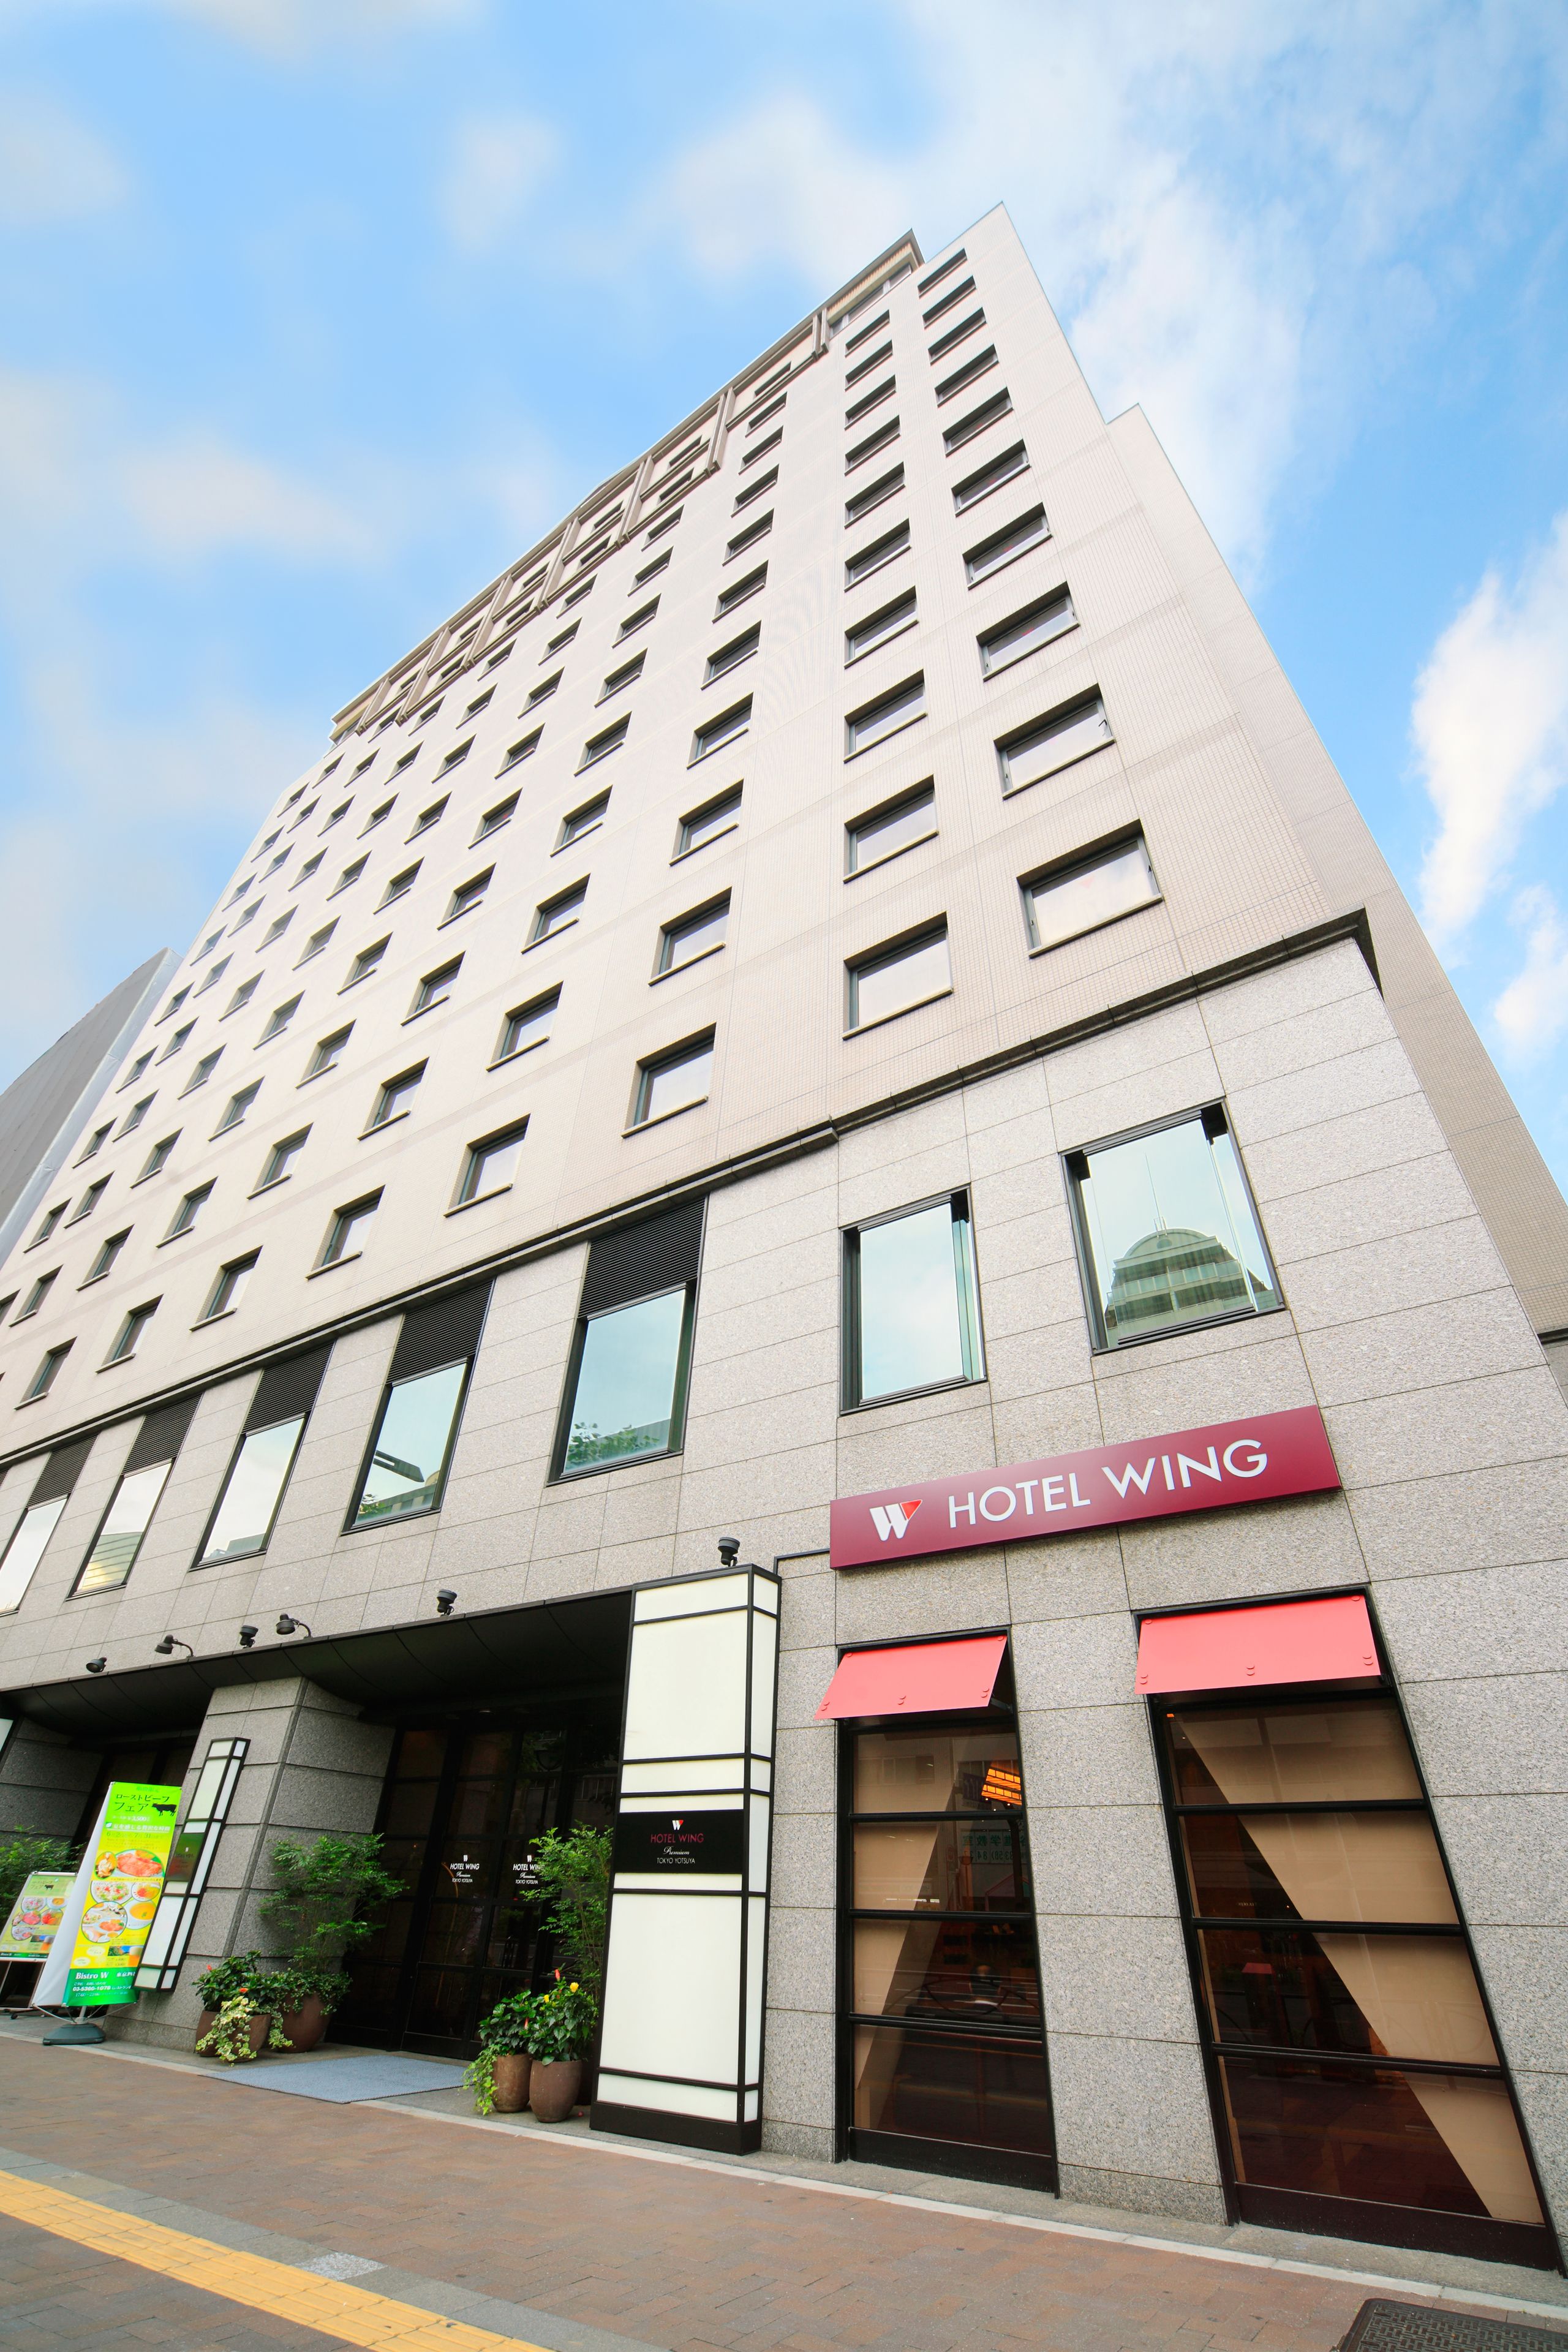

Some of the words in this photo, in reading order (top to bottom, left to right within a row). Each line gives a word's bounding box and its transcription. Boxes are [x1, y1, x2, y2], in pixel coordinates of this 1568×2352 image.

[948, 1472, 1091, 1529] HOTEL
[1101, 1438, 1268, 1496] WING
[116, 1794, 170, 1803] ローストビーフ
[114, 1802, 149, 1812] フェア
[650, 1833, 676, 1843] HOTEL
[678, 1832, 704, 1843] WING
[663, 1845, 690, 1855] Premium
